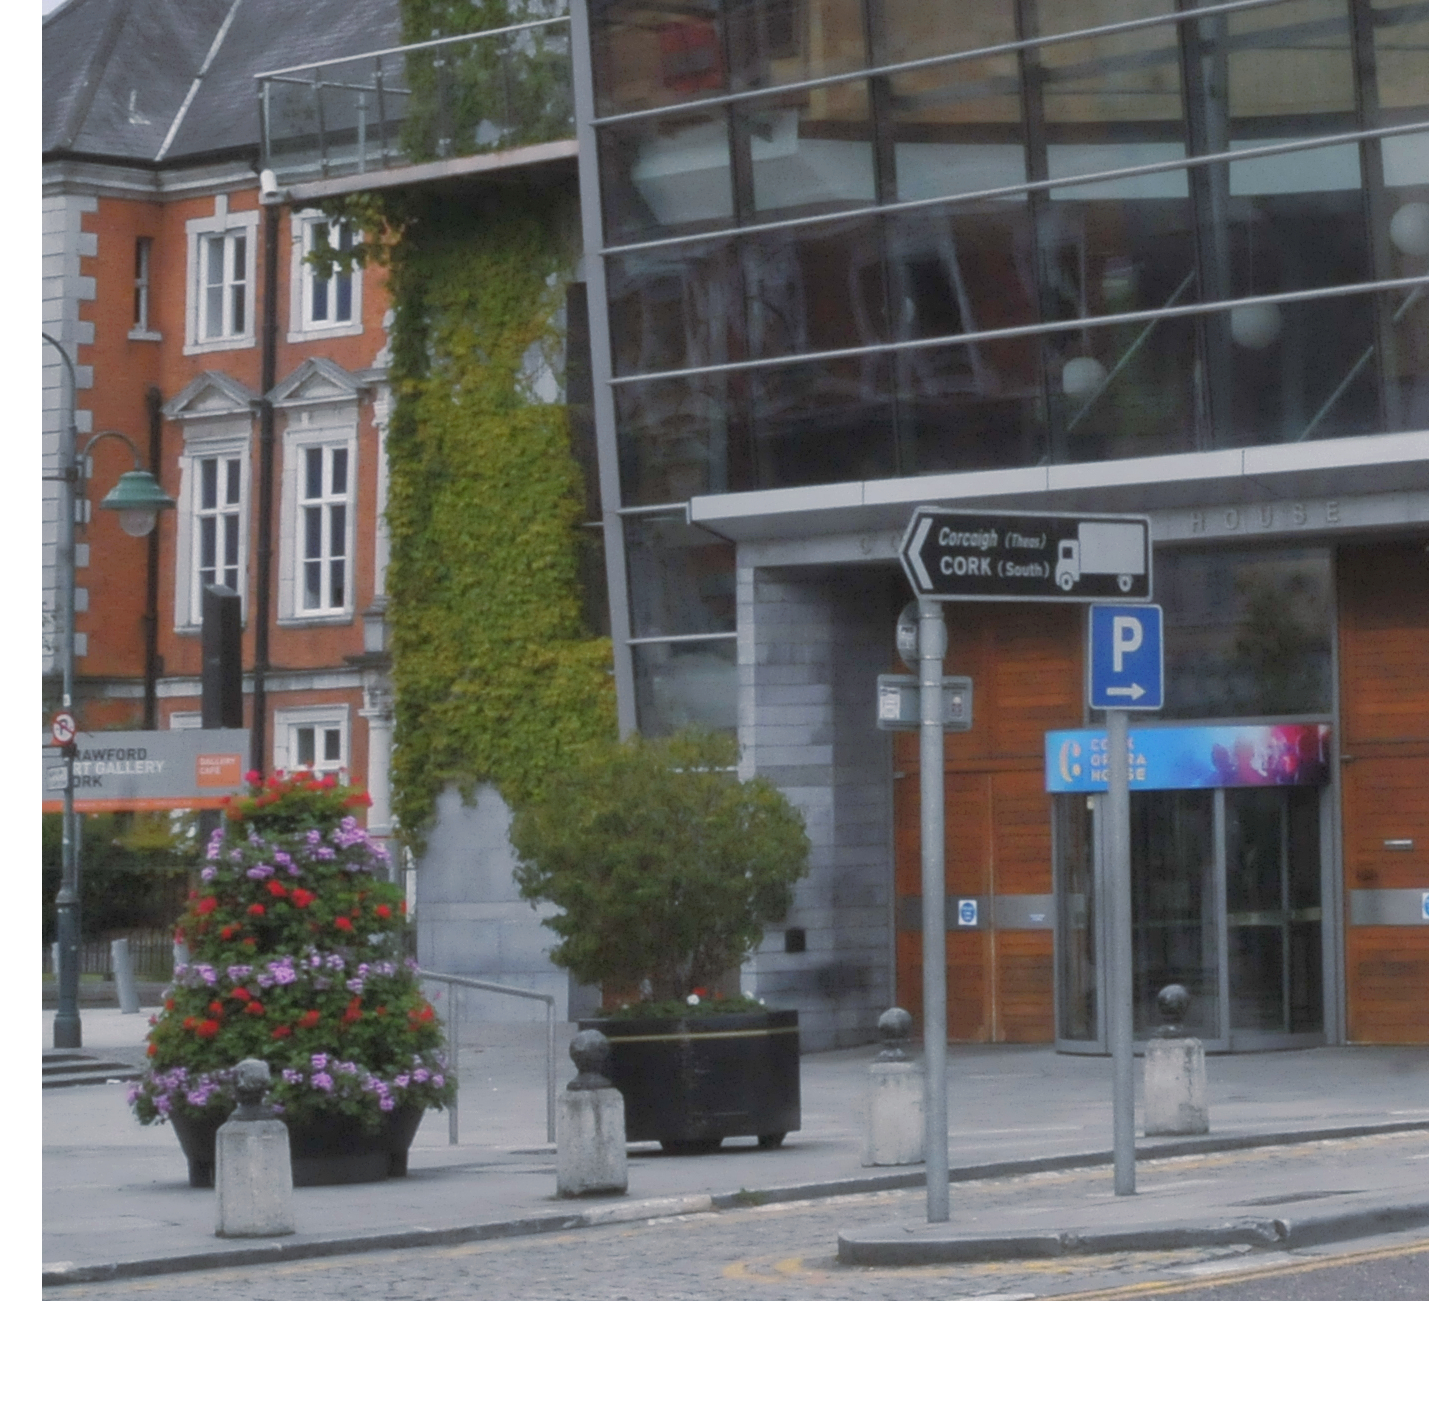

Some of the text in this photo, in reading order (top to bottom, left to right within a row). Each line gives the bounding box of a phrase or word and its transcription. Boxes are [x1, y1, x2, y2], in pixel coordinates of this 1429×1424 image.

[1191, 500, 1339, 533] HOUSE
[938, 527, 1047, 551] Corcaigh (Theas)
[940, 555, 1050, 578] CORK (South)
[1113, 616, 1143, 672] P
[1091, 737, 1135, 751] COK
[73, 747, 147, 761] RAWFORD
[1090, 753, 1147, 766] OPRA
[72, 760, 165, 775] RT GALLERY
[73, 776, 103, 788] ORK
[1090, 768, 1146, 782] HOSE
